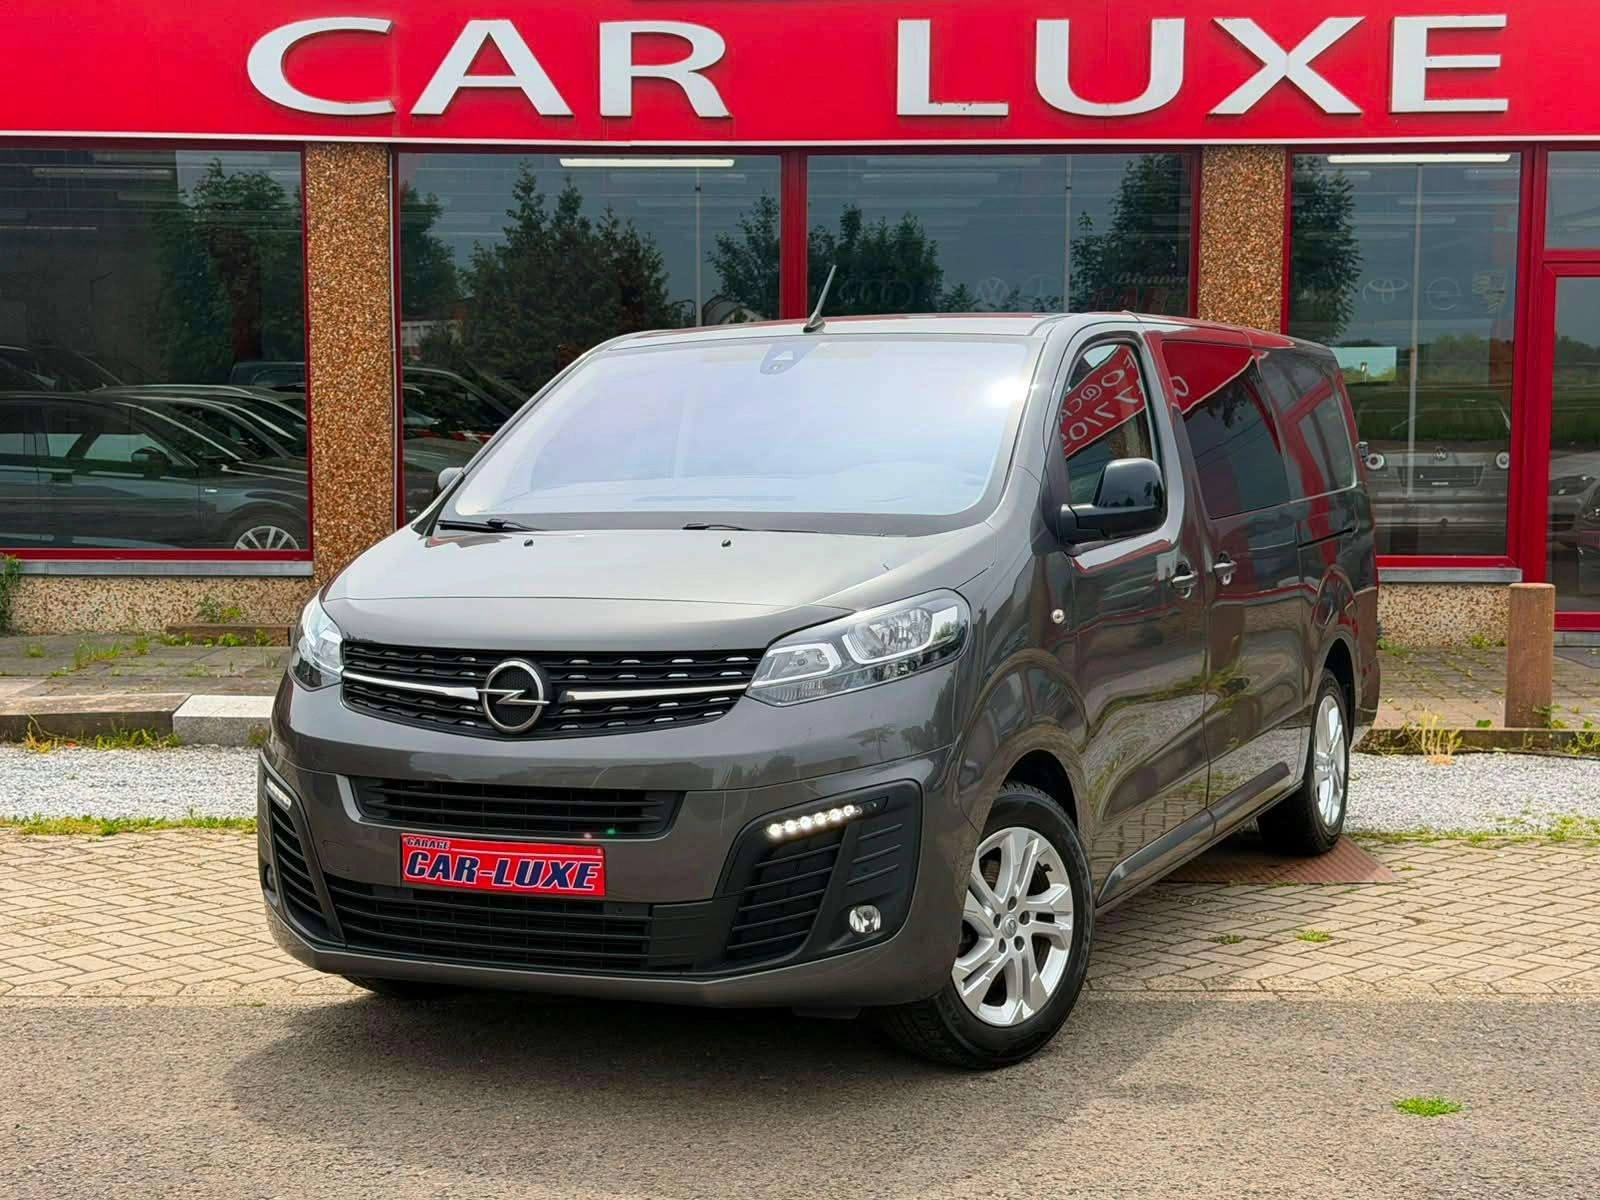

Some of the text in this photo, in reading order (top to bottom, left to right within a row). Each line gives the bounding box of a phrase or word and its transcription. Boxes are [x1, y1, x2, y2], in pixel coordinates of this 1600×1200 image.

[247, 14, 1509, 118] CAR LUXE
[406, 837, 449, 850] GARAGE
[404, 850, 601, 890] CAR-LUXE
